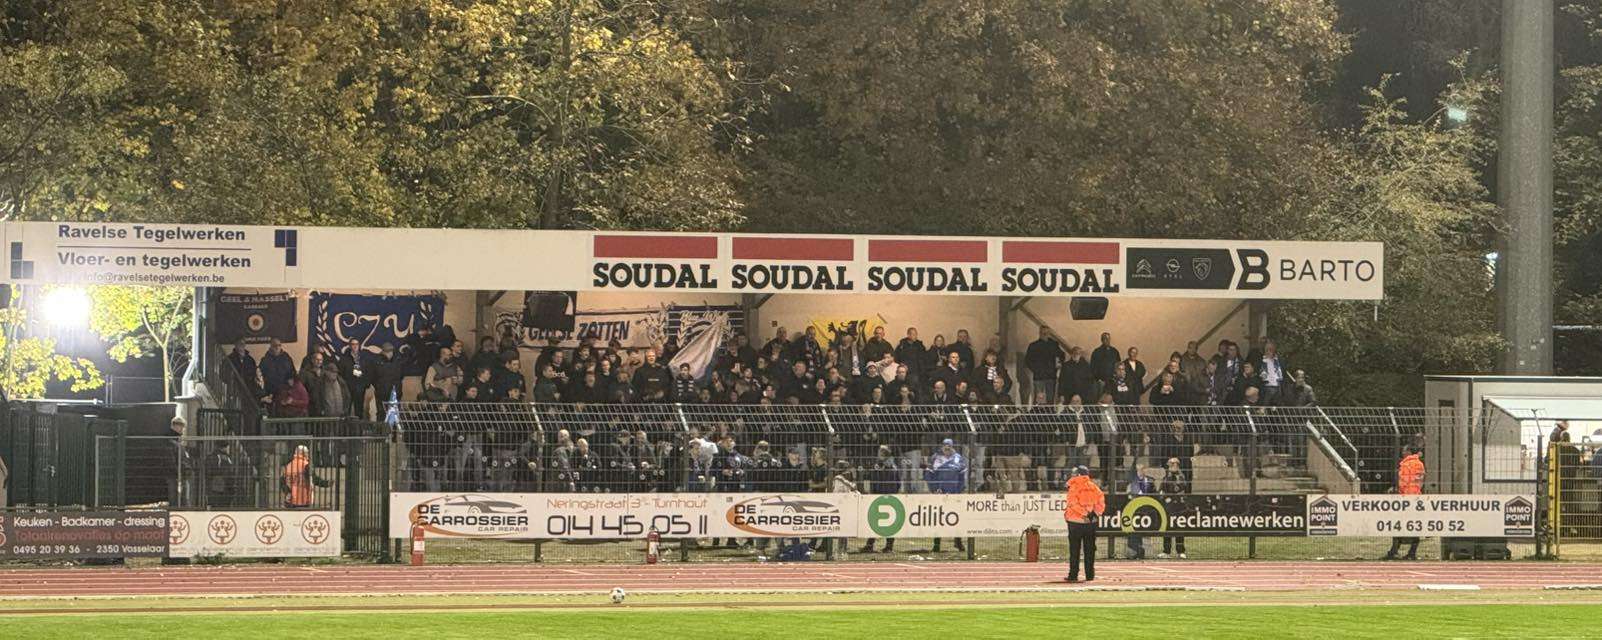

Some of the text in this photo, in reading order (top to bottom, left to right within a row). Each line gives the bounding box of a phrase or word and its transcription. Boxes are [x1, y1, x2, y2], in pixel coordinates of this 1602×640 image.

[58, 224, 246, 242] Ravelse Tegelwerken
[58, 252, 251, 270] Vloer- en tegelwerken
[593, 262, 718, 289] SOUDAL
[731, 264, 854, 290] SOUDAL
[1280, 259, 1375, 282] BARTO
[867, 266, 988, 292] SOUDAL
[1001, 267, 1120, 293] SOUDAL
[417, 504, 440, 514] DE
[546, 498, 627, 510] Neringstraat
[631, 499, 641, 508] 3
[653, 498, 708, 509] Turnhout
[734, 504, 756, 514] DE
[966, 500, 998, 512] MORE
[1001, 501, 1020, 512] than
[1022, 500, 1045, 514] JUST
[1311, 506, 1336, 514] IMMO
[1342, 500, 1501, 511] VERKOOP & VERHUUR
[1506, 506, 1531, 514] IMMO
[13, 516, 53, 527] Keuken
[61, 516, 116, 527] Badkamer
[124, 515, 165, 528] dressing
[417, 515, 529, 525] CARROSSIER
[734, 515, 840, 525] CARROSSIER
[909, 504, 959, 527] dilito
[1098, 510, 1304, 528] irdeco reclamewerken
[547, 515, 708, 535] 014 45 05 11
[1377, 520, 1465, 532] 014 63 50 52
[13, 545, 37, 554] 0495
[39, 545, 51, 554] 20
[54, 545, 66, 554] 39
[68, 545, 81, 554] 36
[96, 544, 120, 553] 2350
